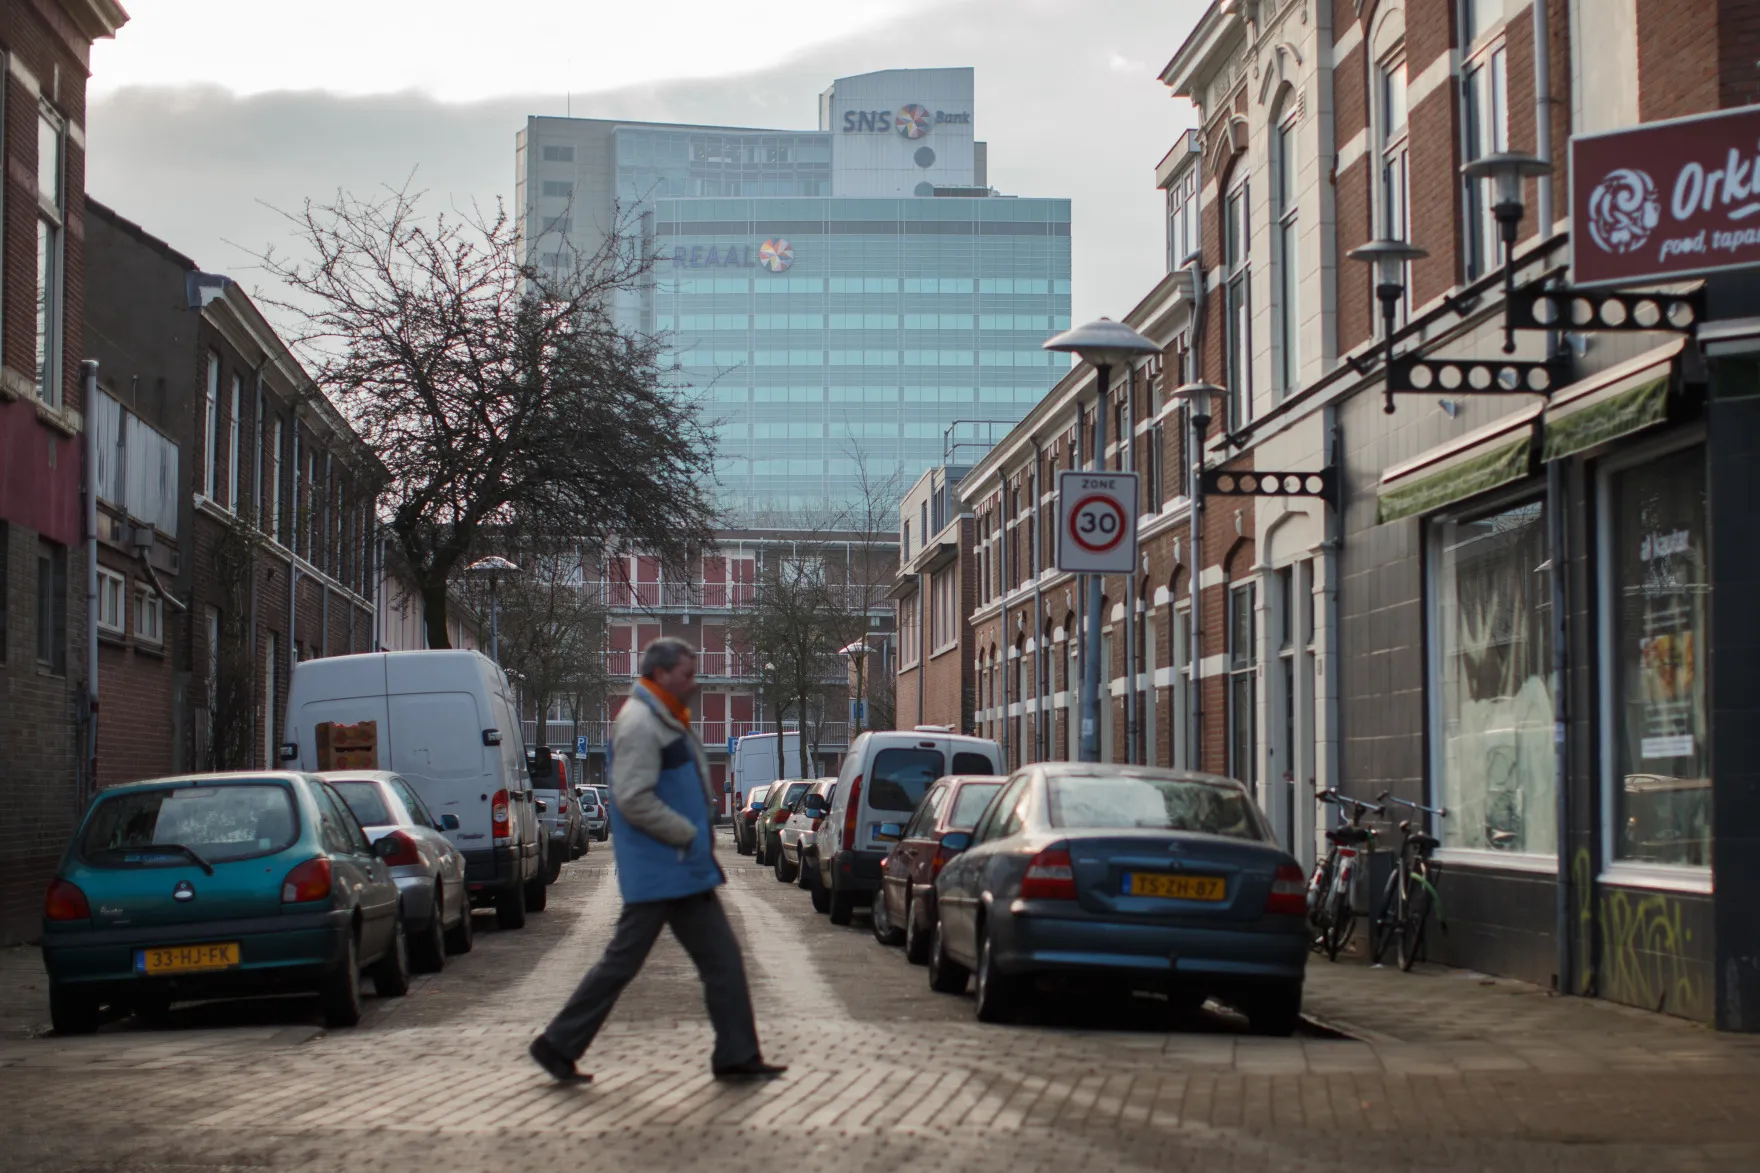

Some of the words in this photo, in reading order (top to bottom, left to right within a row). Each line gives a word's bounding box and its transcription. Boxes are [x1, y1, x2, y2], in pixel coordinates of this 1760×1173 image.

[843, 110, 891, 133] SNS
[936, 111, 970, 124] Bank
[673, 245, 756, 268] REAAL
[1082, 479, 1116, 490] ZONE
[1080, 512, 1117, 534] 30
[1138, 876, 1219, 898] TS-ZH-87
[152, 946, 231, 968] 33-HJ-FK
